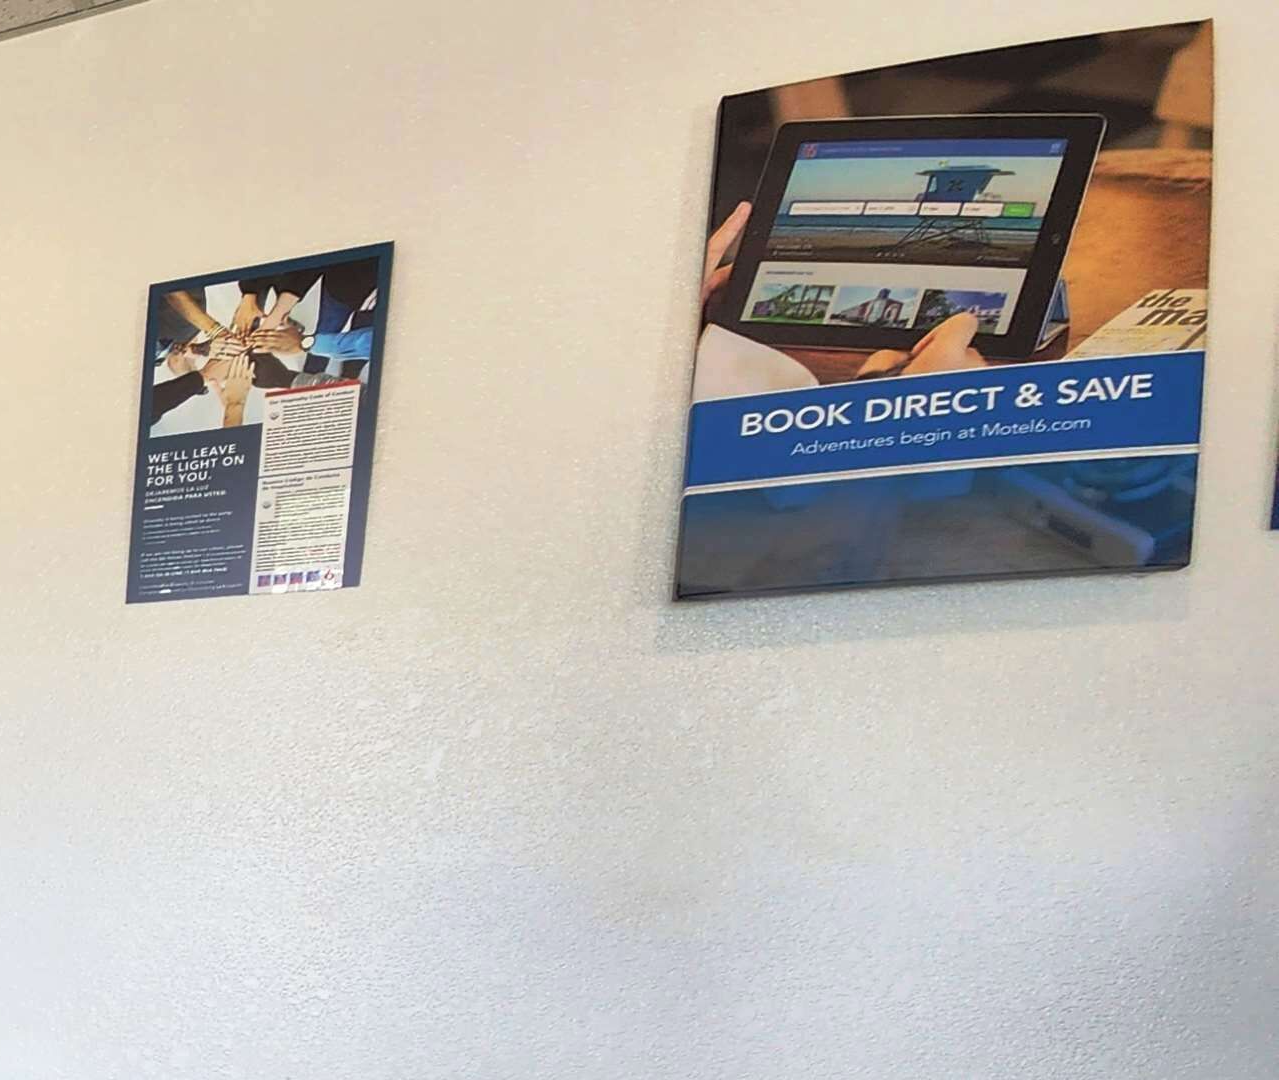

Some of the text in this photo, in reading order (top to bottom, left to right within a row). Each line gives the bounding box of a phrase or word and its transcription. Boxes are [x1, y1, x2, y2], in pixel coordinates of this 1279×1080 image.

[1137, 287, 1193, 309] the
[739, 373, 1154, 437] BOOK DIRECT & SAVE
[790, 416, 1092, 457] Adventures begin at Motel6.com
[147, 443, 237, 464] WE'LL LEAVE
[146, 454, 245, 476] THE LIGHT ON
[146, 471, 213, 488] FOR YOU.
